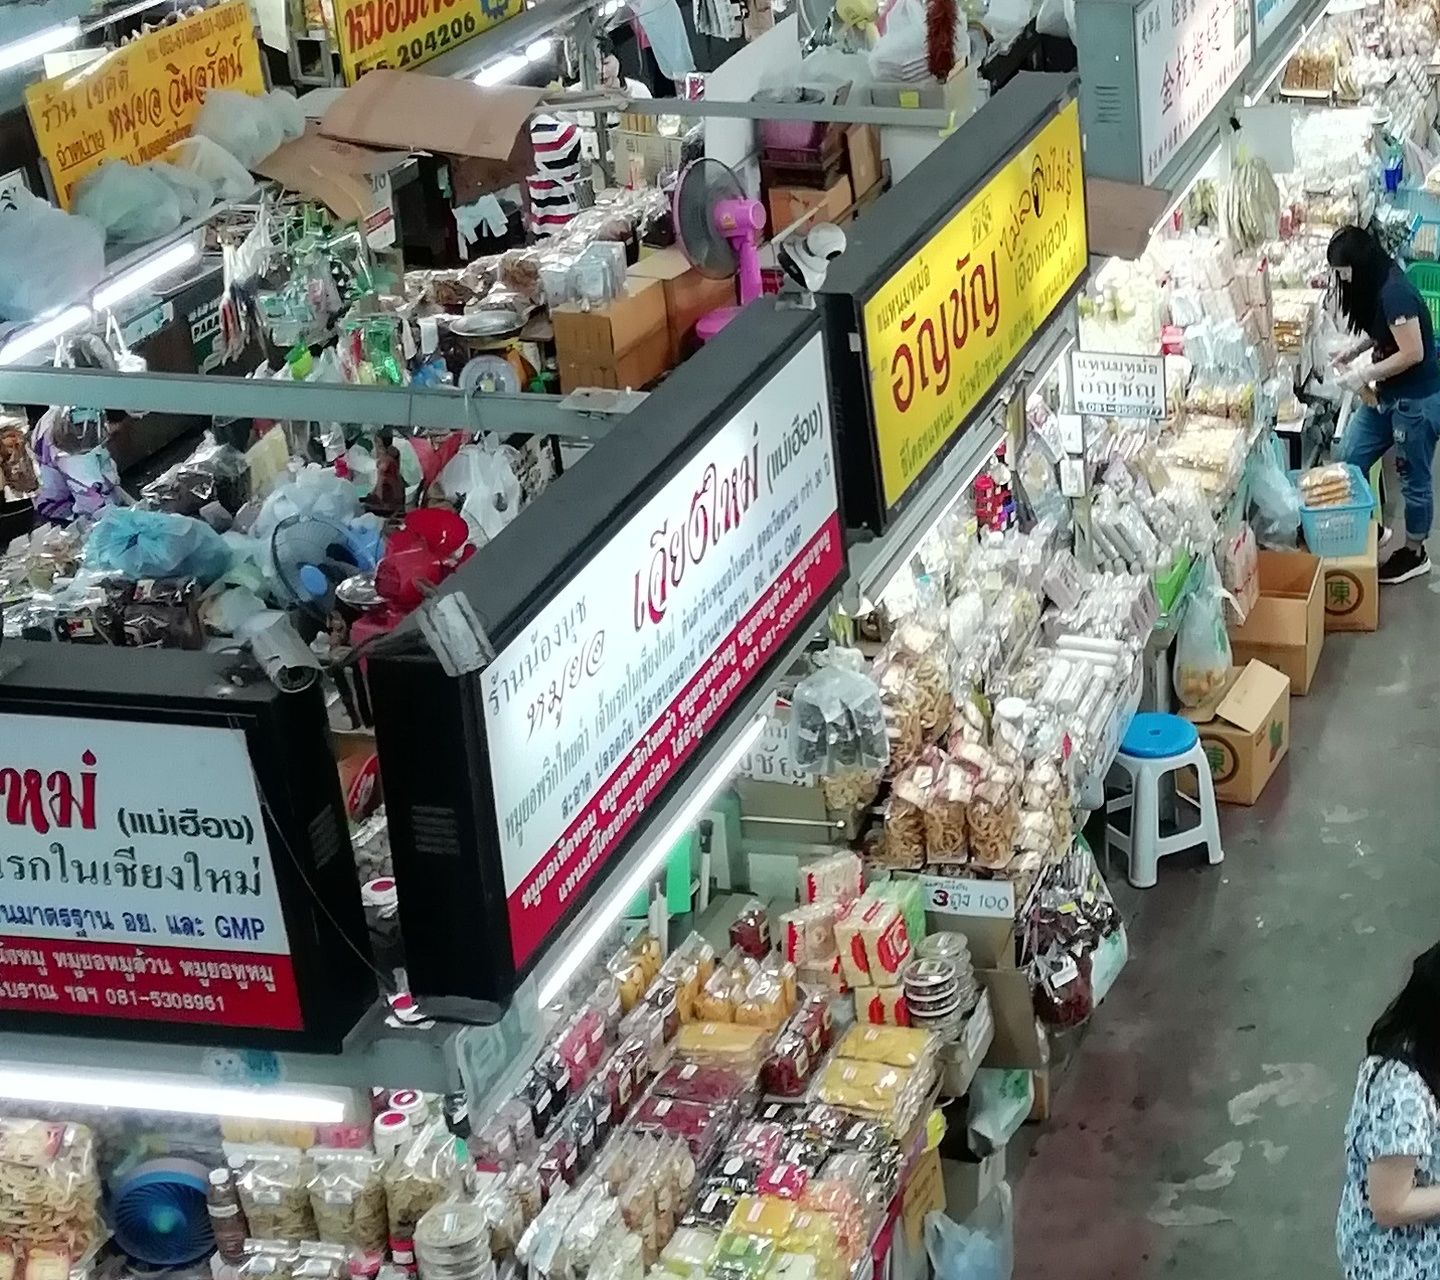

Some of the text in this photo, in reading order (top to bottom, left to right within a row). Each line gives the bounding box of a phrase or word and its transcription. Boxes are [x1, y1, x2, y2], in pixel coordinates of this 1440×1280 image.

[396, 11, 477, 67] 204206
[889, 250, 1001, 414] อัญชัญ
[784, 522, 802, 560] GMP
[117, 806, 256, 846] (แม่เฮือง)
[0, 841, 263, 898] รกในเชียงใหม่
[979, 893, 1010, 912] 100
[121, 911, 158, 935] อย.
[165, 913, 206, 938] และ
[214, 914, 266, 942] GMP
[105, 988, 226, 1013] 081-5308961
